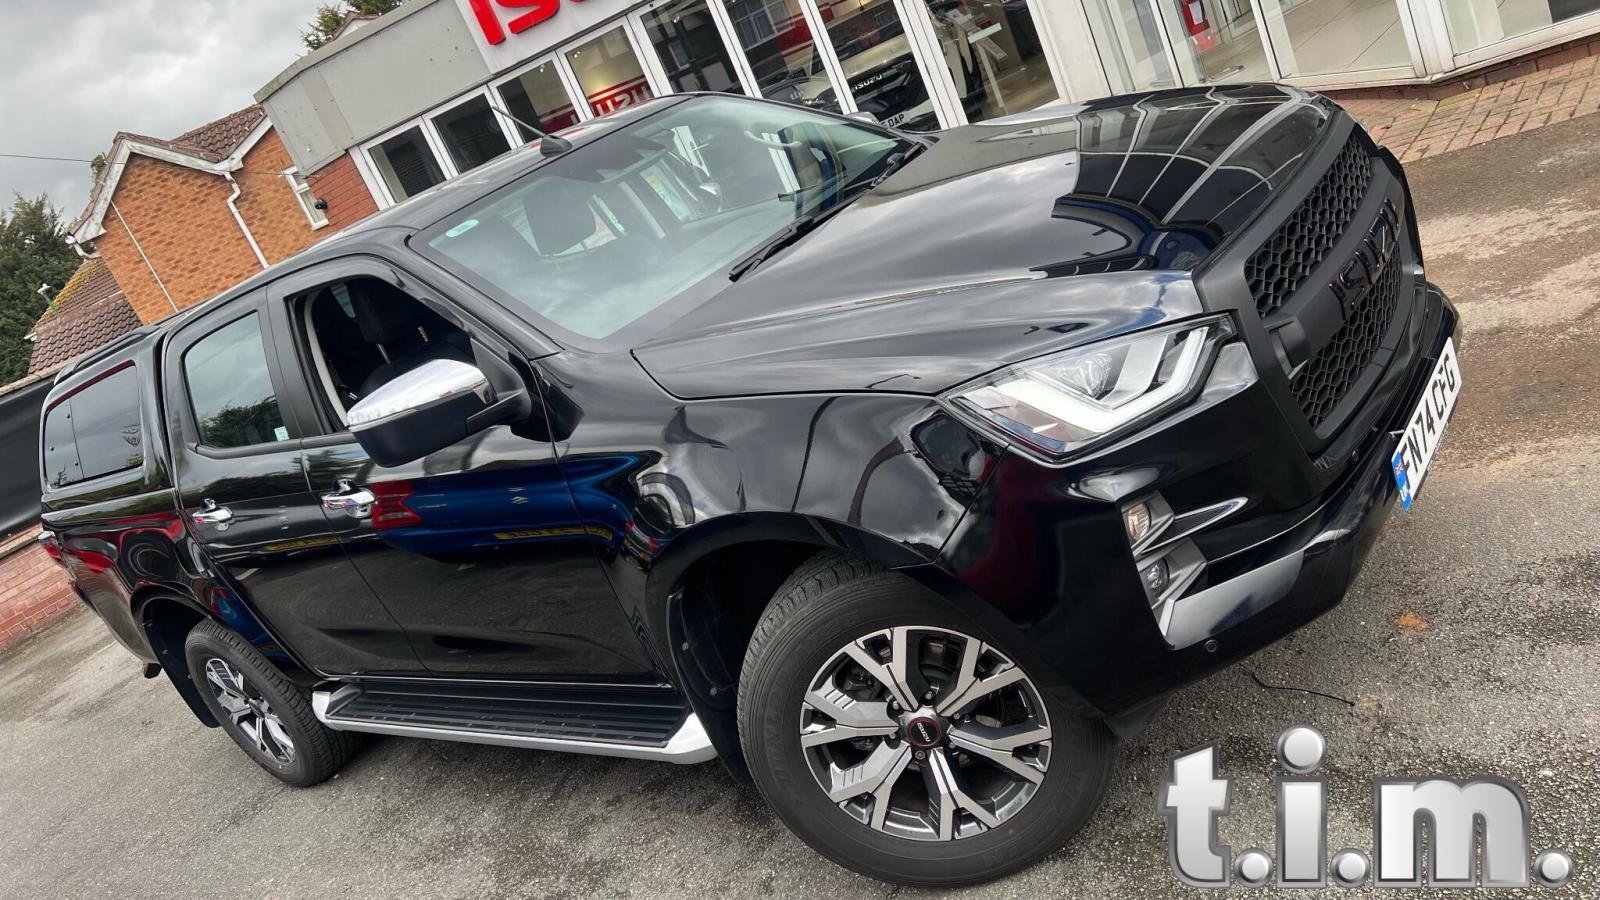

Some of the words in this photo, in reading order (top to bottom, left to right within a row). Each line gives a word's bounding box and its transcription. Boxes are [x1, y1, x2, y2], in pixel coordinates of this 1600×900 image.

[855, 73, 883, 90] ISUZU
[1328, 197, 1400, 321] ISUZU
[1400, 398, 1436, 491] FN74
[1431, 353, 1456, 421] CFG
[916, 722, 931, 742] ISUZU
